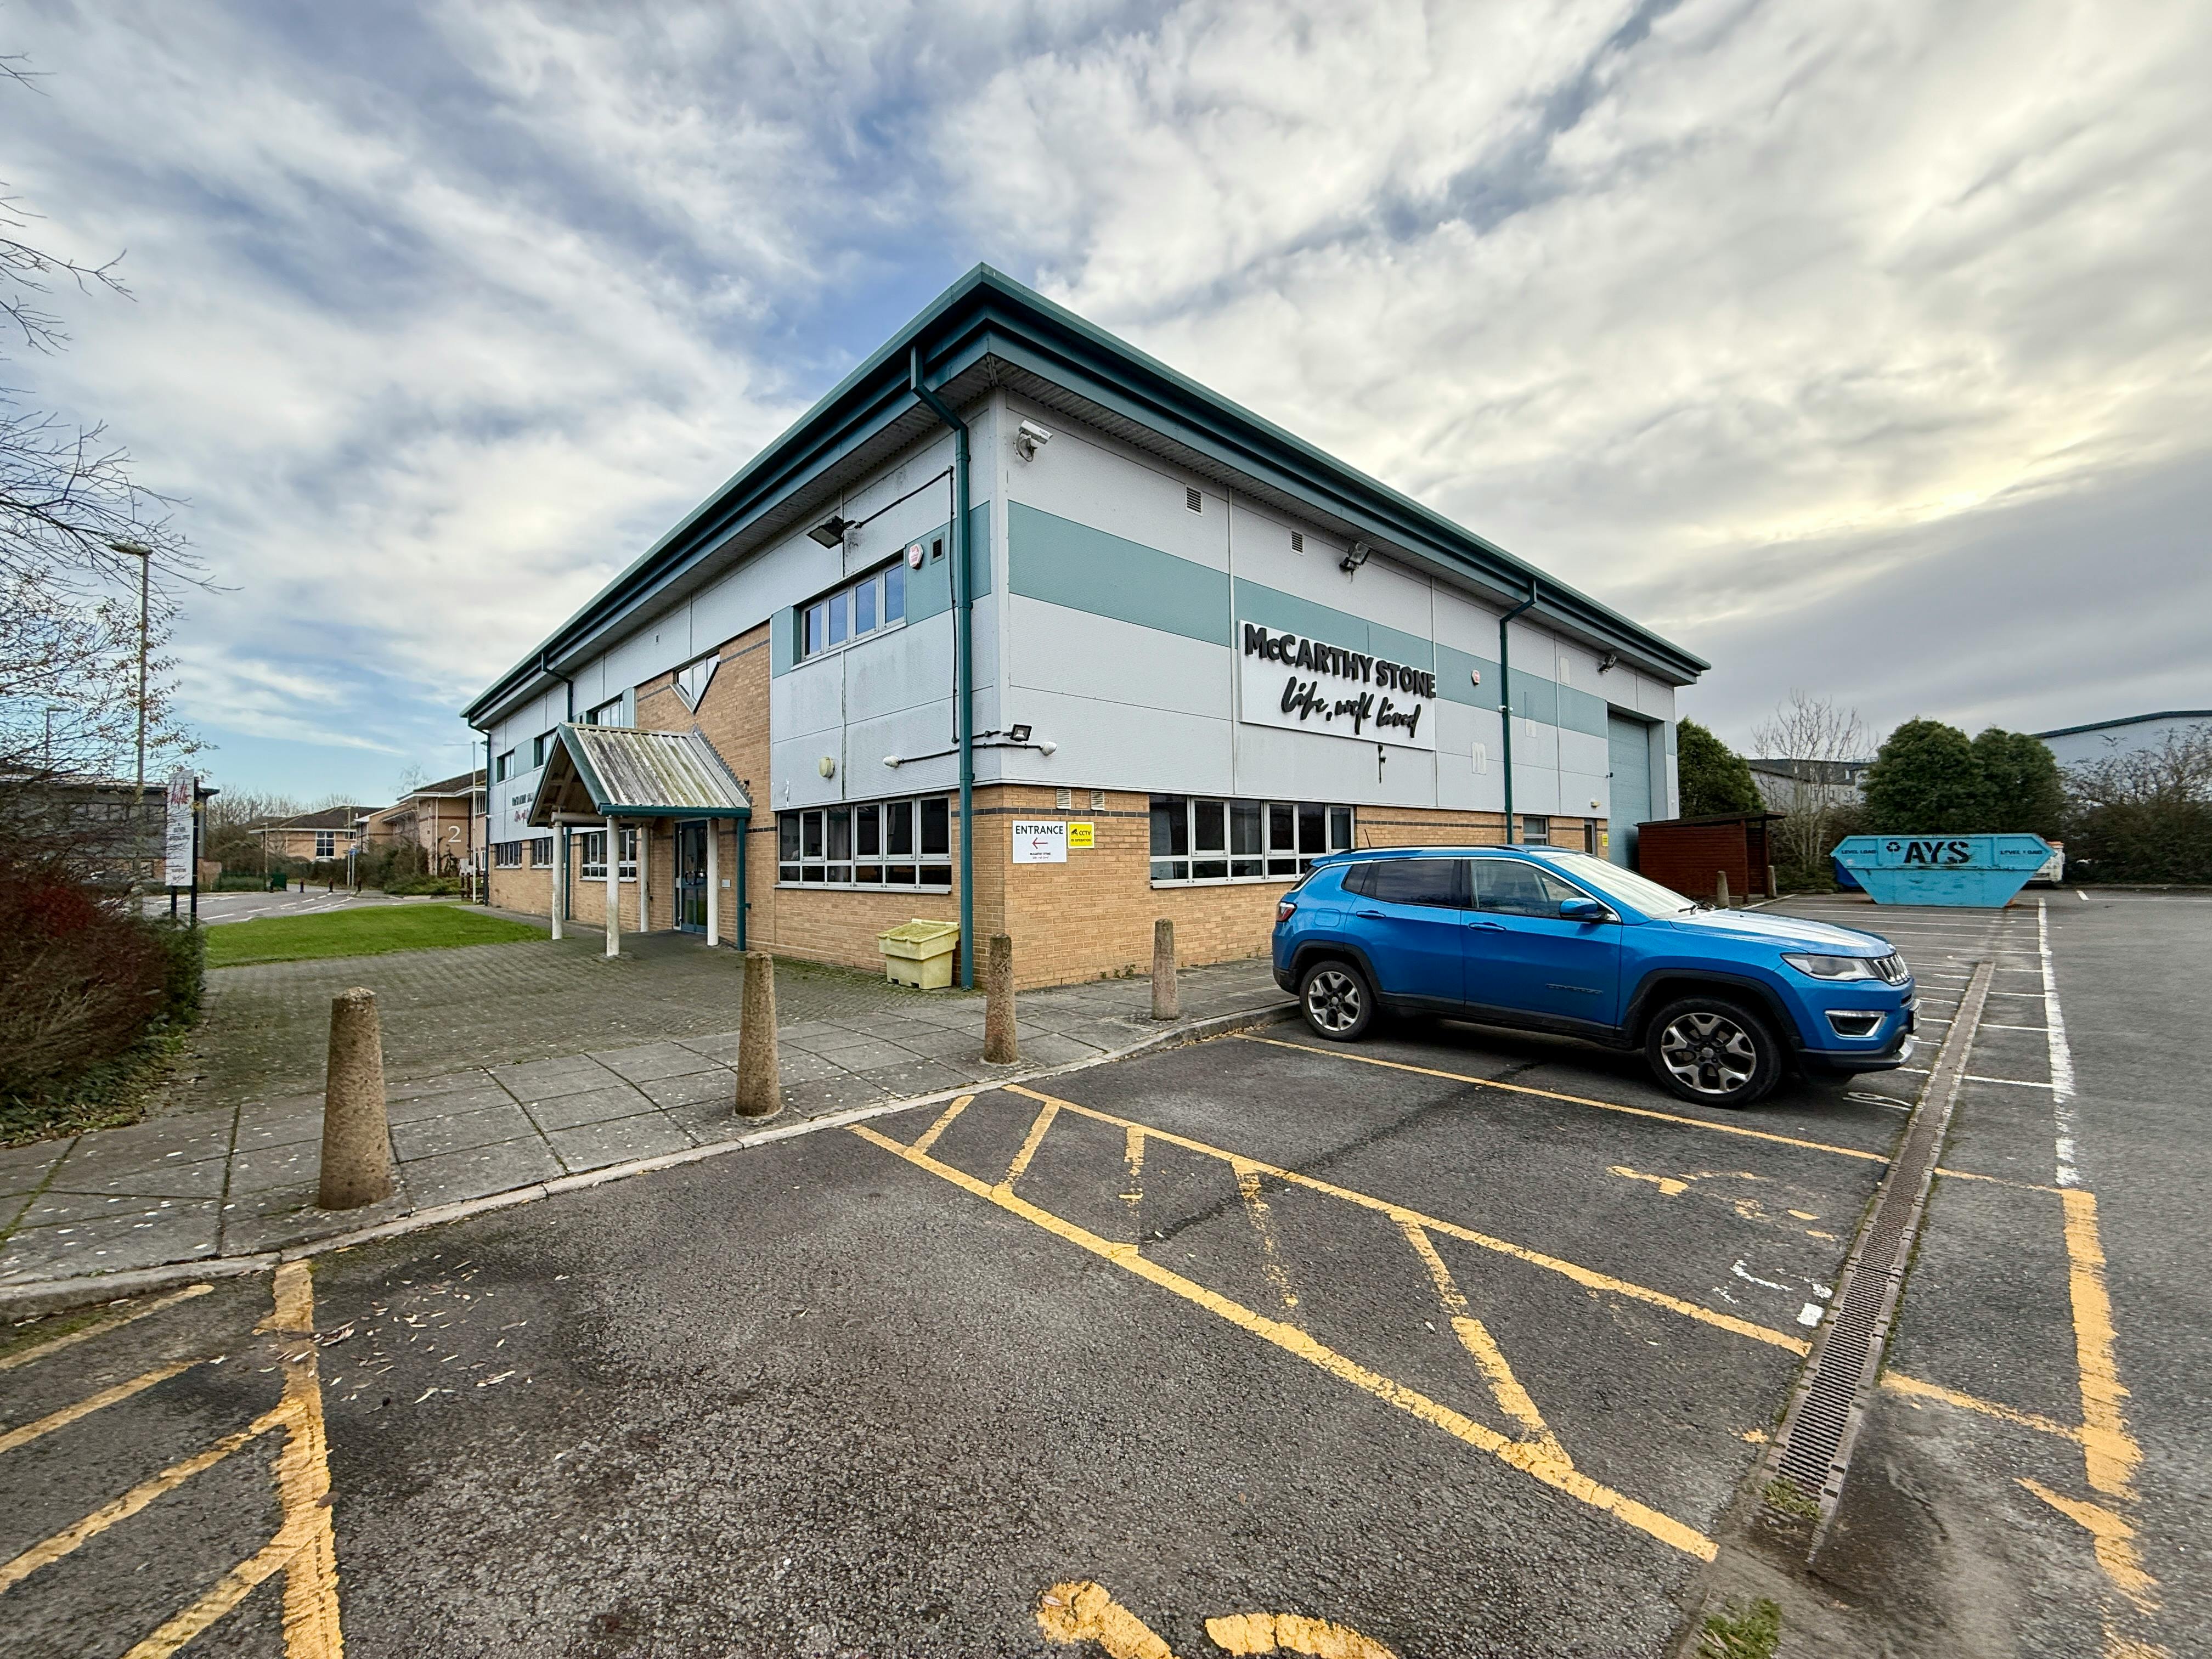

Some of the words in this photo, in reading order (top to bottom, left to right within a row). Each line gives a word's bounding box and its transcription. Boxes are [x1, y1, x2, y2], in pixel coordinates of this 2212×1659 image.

[1244, 623, 1374, 682] McCARTHY
[1375, 660, 1436, 698] STONE
[448, 826, 461, 842] 2
[1015, 825, 1064, 834] ENTRANCE
[1903, 841, 1969, 864] AYS
